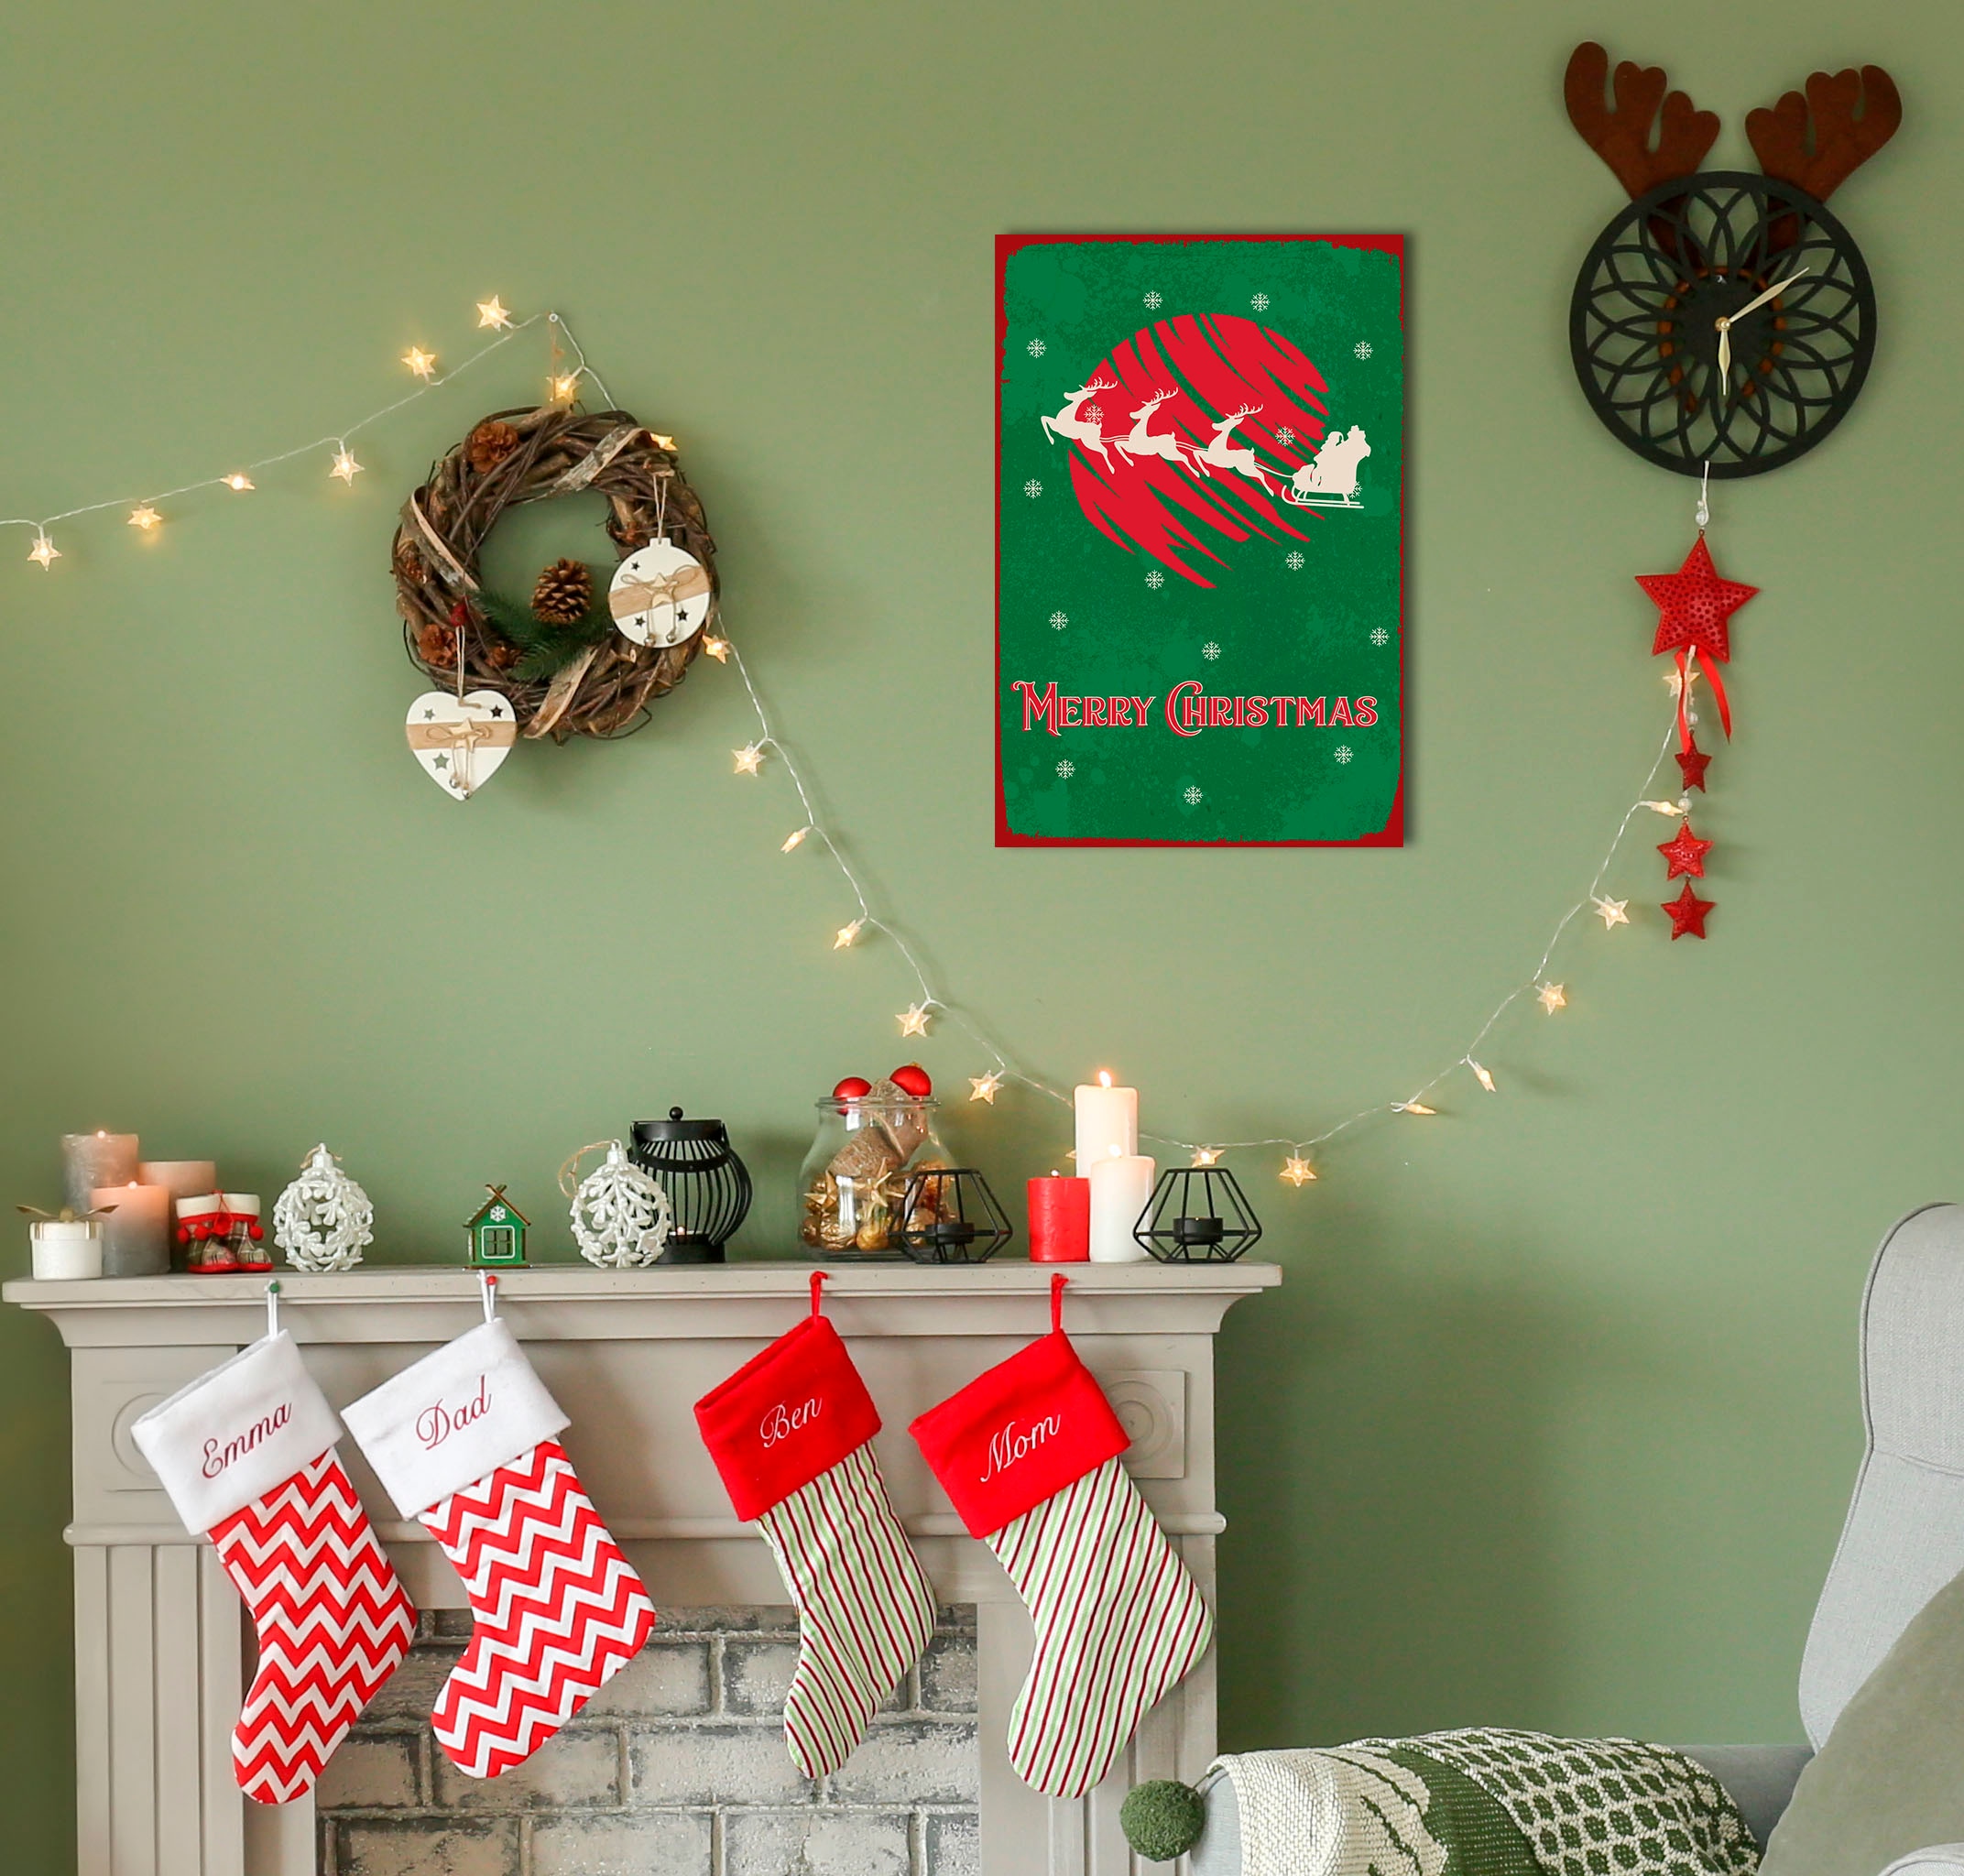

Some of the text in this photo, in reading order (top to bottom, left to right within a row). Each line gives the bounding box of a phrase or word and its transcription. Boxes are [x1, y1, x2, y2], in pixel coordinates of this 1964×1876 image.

[1010, 680, 1380, 738] MERRY CHRISTMAS
[202, 1402, 292, 1478] Emma
[416, 1374, 492, 1451] Dad
[759, 1397, 823, 1449] Ben
[979, 1413, 1062, 1483] Mom
